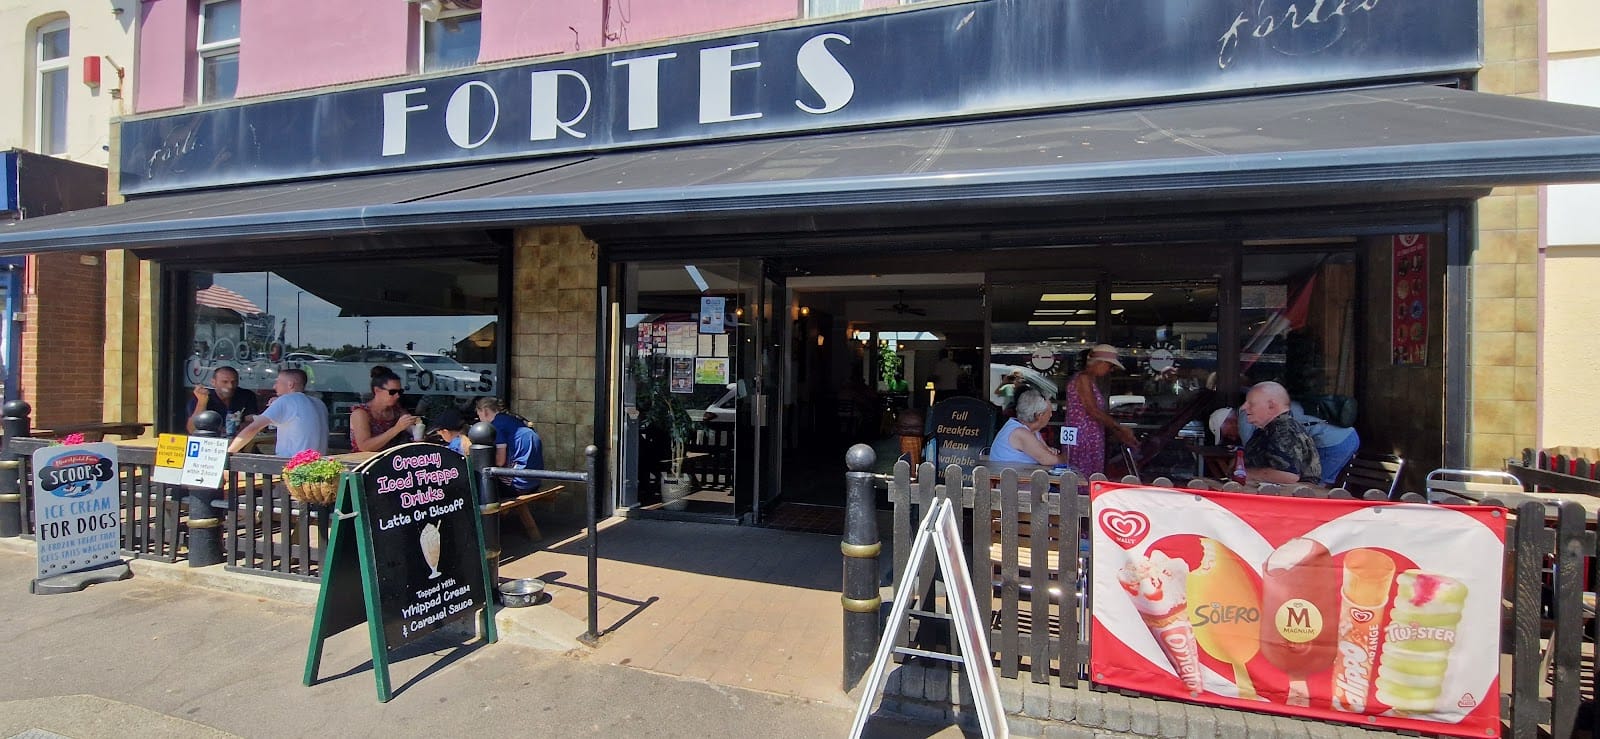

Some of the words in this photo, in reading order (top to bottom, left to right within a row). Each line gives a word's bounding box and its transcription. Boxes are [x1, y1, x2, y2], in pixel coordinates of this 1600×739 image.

[381, 32, 855, 157] FORTES
[951, 410, 969, 421] Full
[936, 424, 980, 437] Breakfast
[1062, 429, 1075, 442] 35
[942, 439, 969, 451] Menu
[393, 452, 442, 471] Creamy
[938, 454, 976, 466] vailable
[377, 471, 414, 494] Iced
[415, 467, 459, 486] Frappe
[45, 504, 65, 519] ICE
[70, 496, 111, 515] CREAM
[400, 486, 445, 509] Drinks
[379, 513, 412, 530] Latte
[413, 509, 427, 521] Or
[429, 498, 464, 518] Biscoff
[40, 520, 71, 541] FOR
[77, 511, 117, 534] DOGS
[401, 593, 442, 619] Whipped
[443, 584, 471, 602] Cream
[416, 582, 440, 599] Topped
[410, 606, 447, 632] Caramel
[448, 598, 473, 615] Sauce
[1191, 603, 1260, 627] SOLERO
[1286, 606, 1312, 628] M
[1283, 627, 1315, 635] MAGNUM
